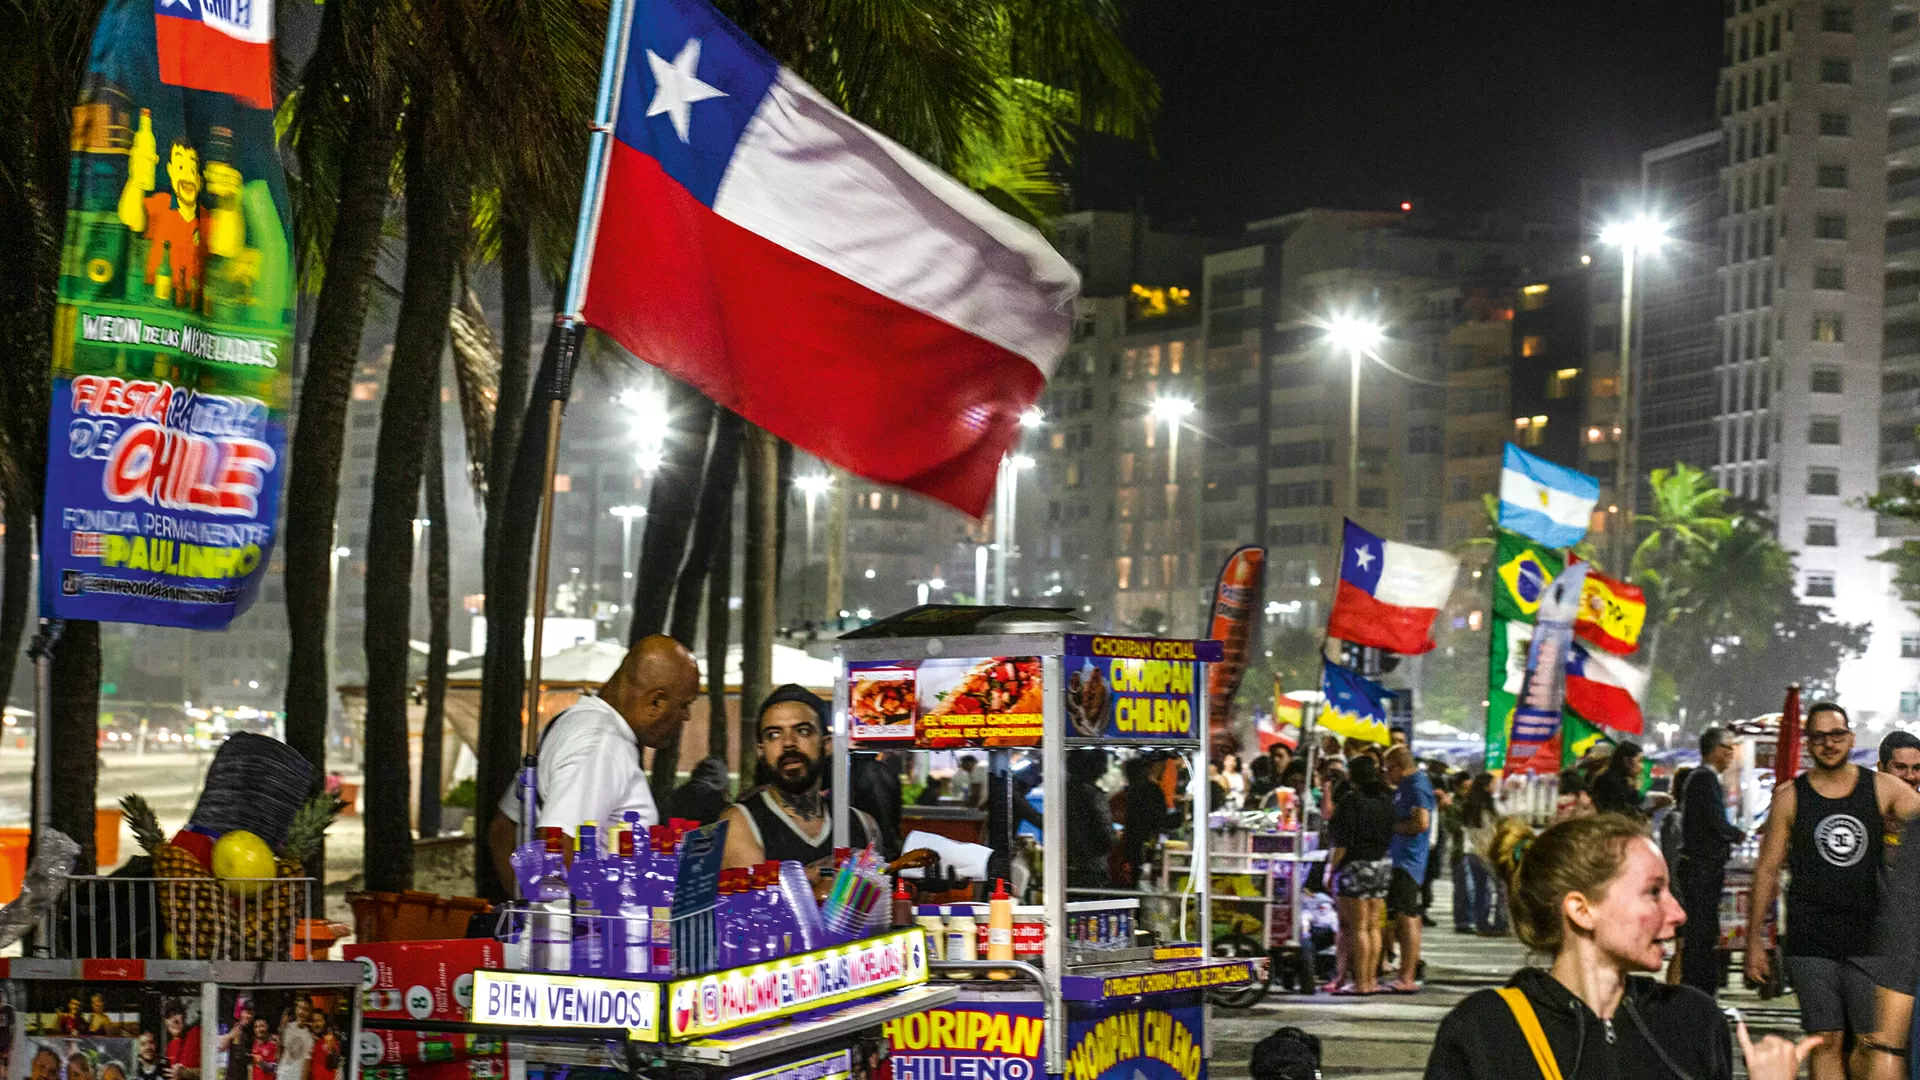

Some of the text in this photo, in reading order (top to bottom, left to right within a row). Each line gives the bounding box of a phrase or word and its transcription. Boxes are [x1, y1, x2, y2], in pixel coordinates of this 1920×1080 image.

[83, 313, 142, 344] WEON
[180, 325, 279, 369] MICHELADAS
[71, 375, 174, 427] FIESTA
[102, 421, 276, 520] CHILE
[63, 507, 140, 534] FONDA
[101, 533, 262, 579] PAULINHO
[1092, 636, 1197, 660] CHORIPAN OFICIAL
[1110, 657, 1194, 733] CHORIPAN CHILENO
[411, 996, 429, 1010] 8
[488, 982, 537, 1018] BIEN
[360, 1040, 379, 1061] 12
[881, 1010, 1044, 1058] HORIPAN
[892, 1056, 1034, 1080] HILENO
